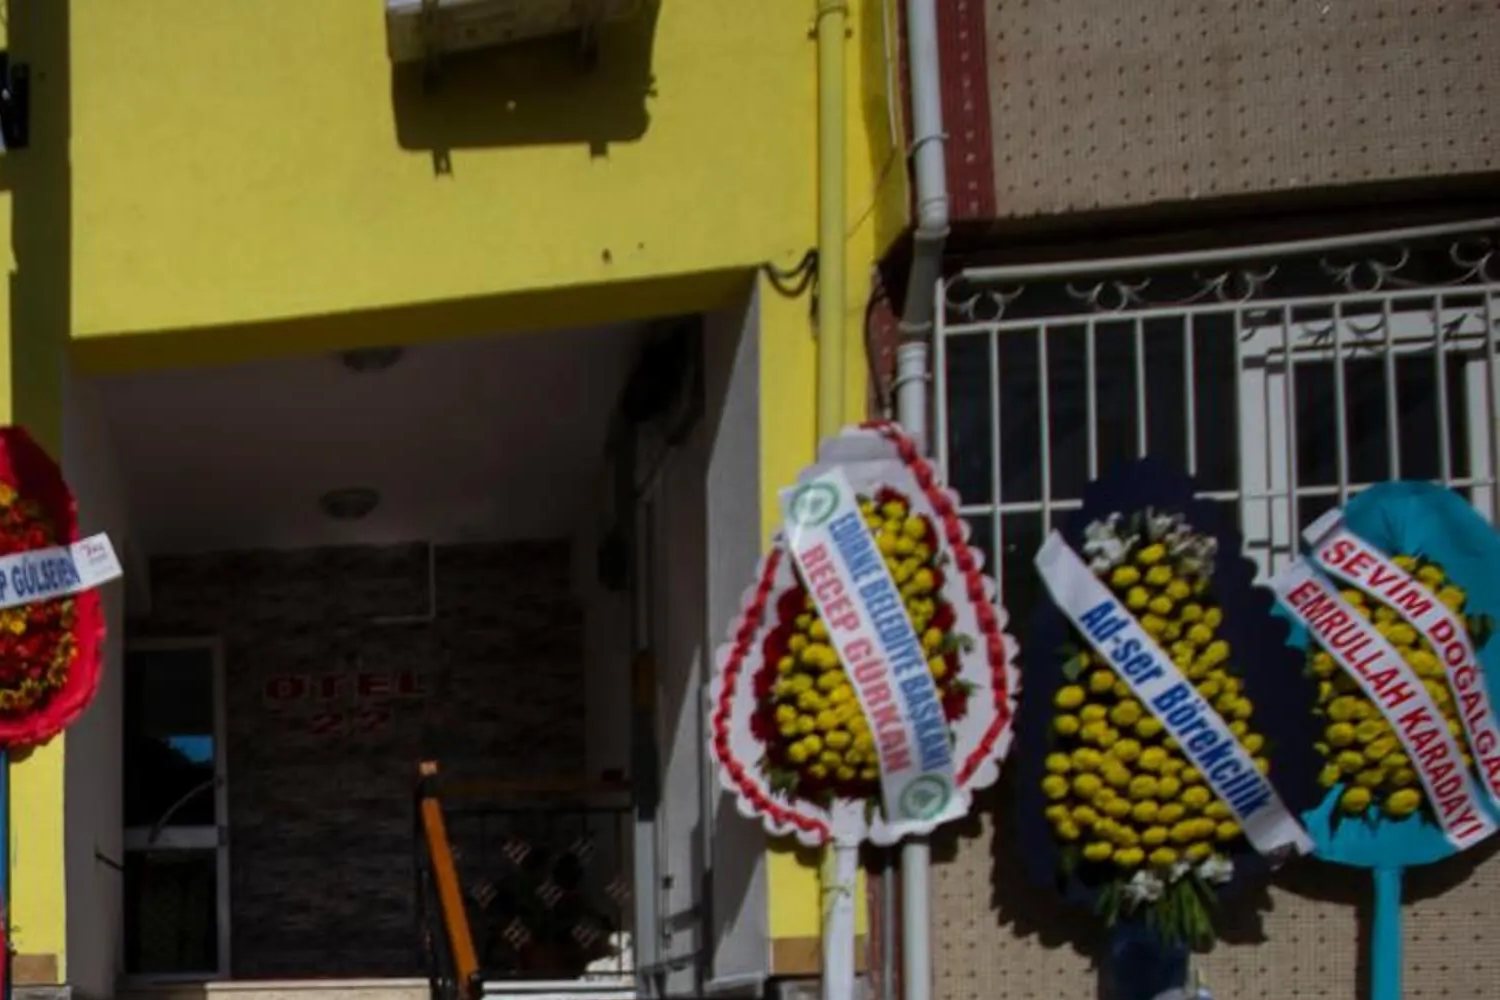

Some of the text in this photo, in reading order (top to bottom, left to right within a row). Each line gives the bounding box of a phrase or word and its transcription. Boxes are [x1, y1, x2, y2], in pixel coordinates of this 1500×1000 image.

[1320, 538, 1434, 620] SEVİM
[265, 671, 427, 699] OTEL
[801, 543, 912, 773] RECEP GÜRKAN
[1079, 600, 1163, 687] Ad-ser
[310, 709, 391, 734] 22
[1286, 580, 1484, 839] EMRULLAH KARADAYI
